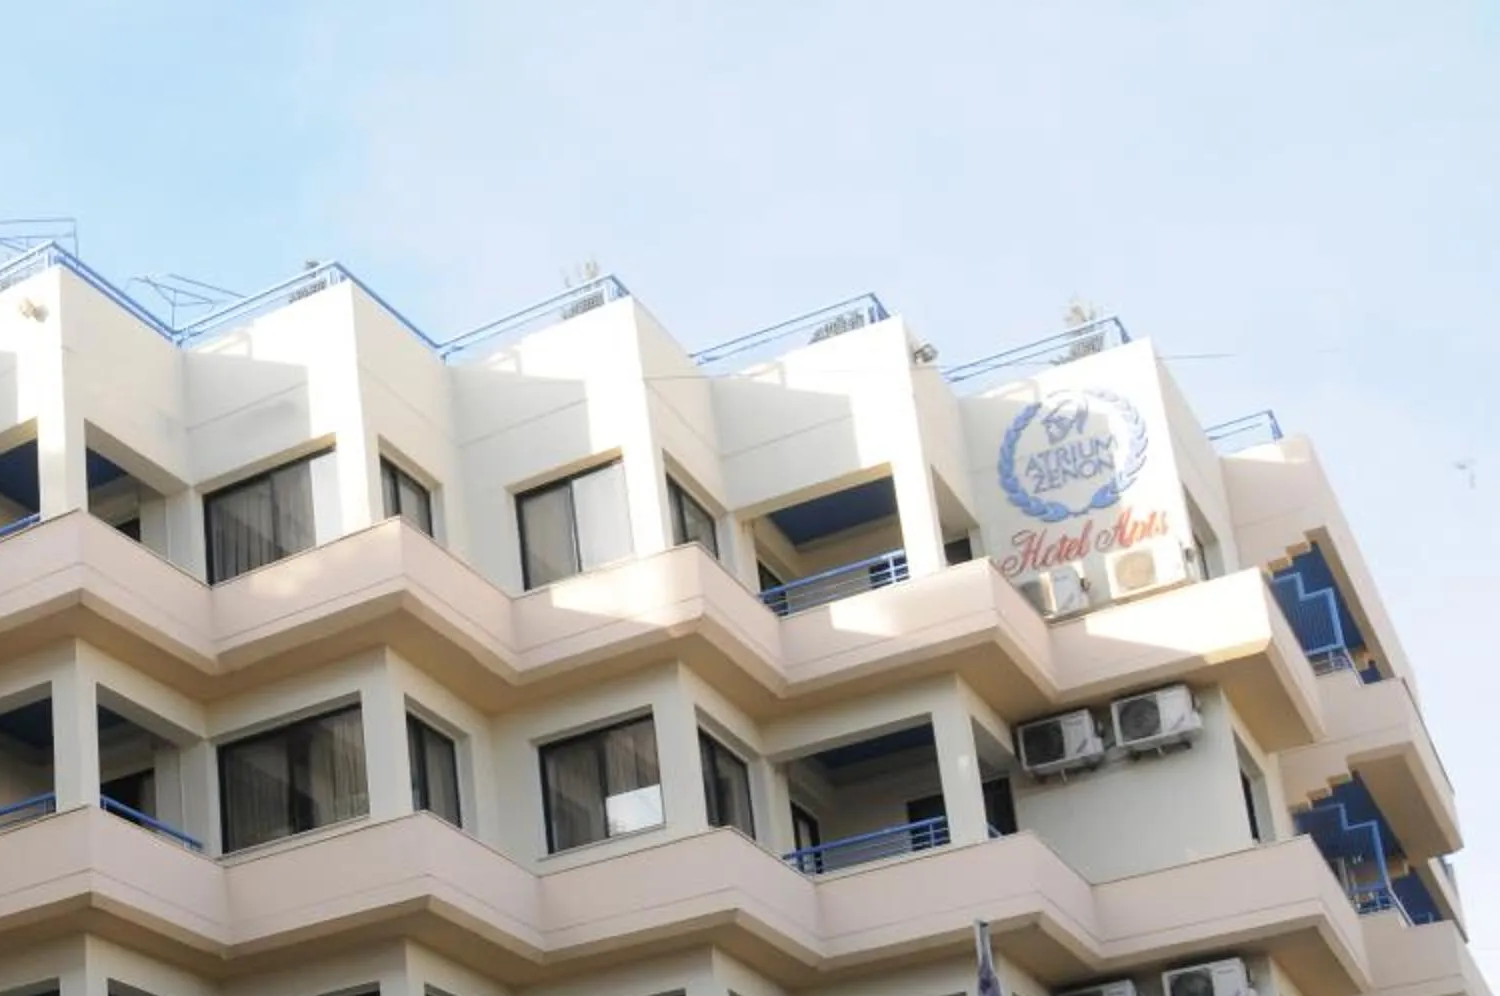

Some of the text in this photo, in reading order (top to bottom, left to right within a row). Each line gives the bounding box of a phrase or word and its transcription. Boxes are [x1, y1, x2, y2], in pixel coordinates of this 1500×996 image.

[1025, 435, 1118, 477] ATRIUM
[1033, 452, 1115, 493] ZENON
[1001, 519, 1093, 578] Hotel
